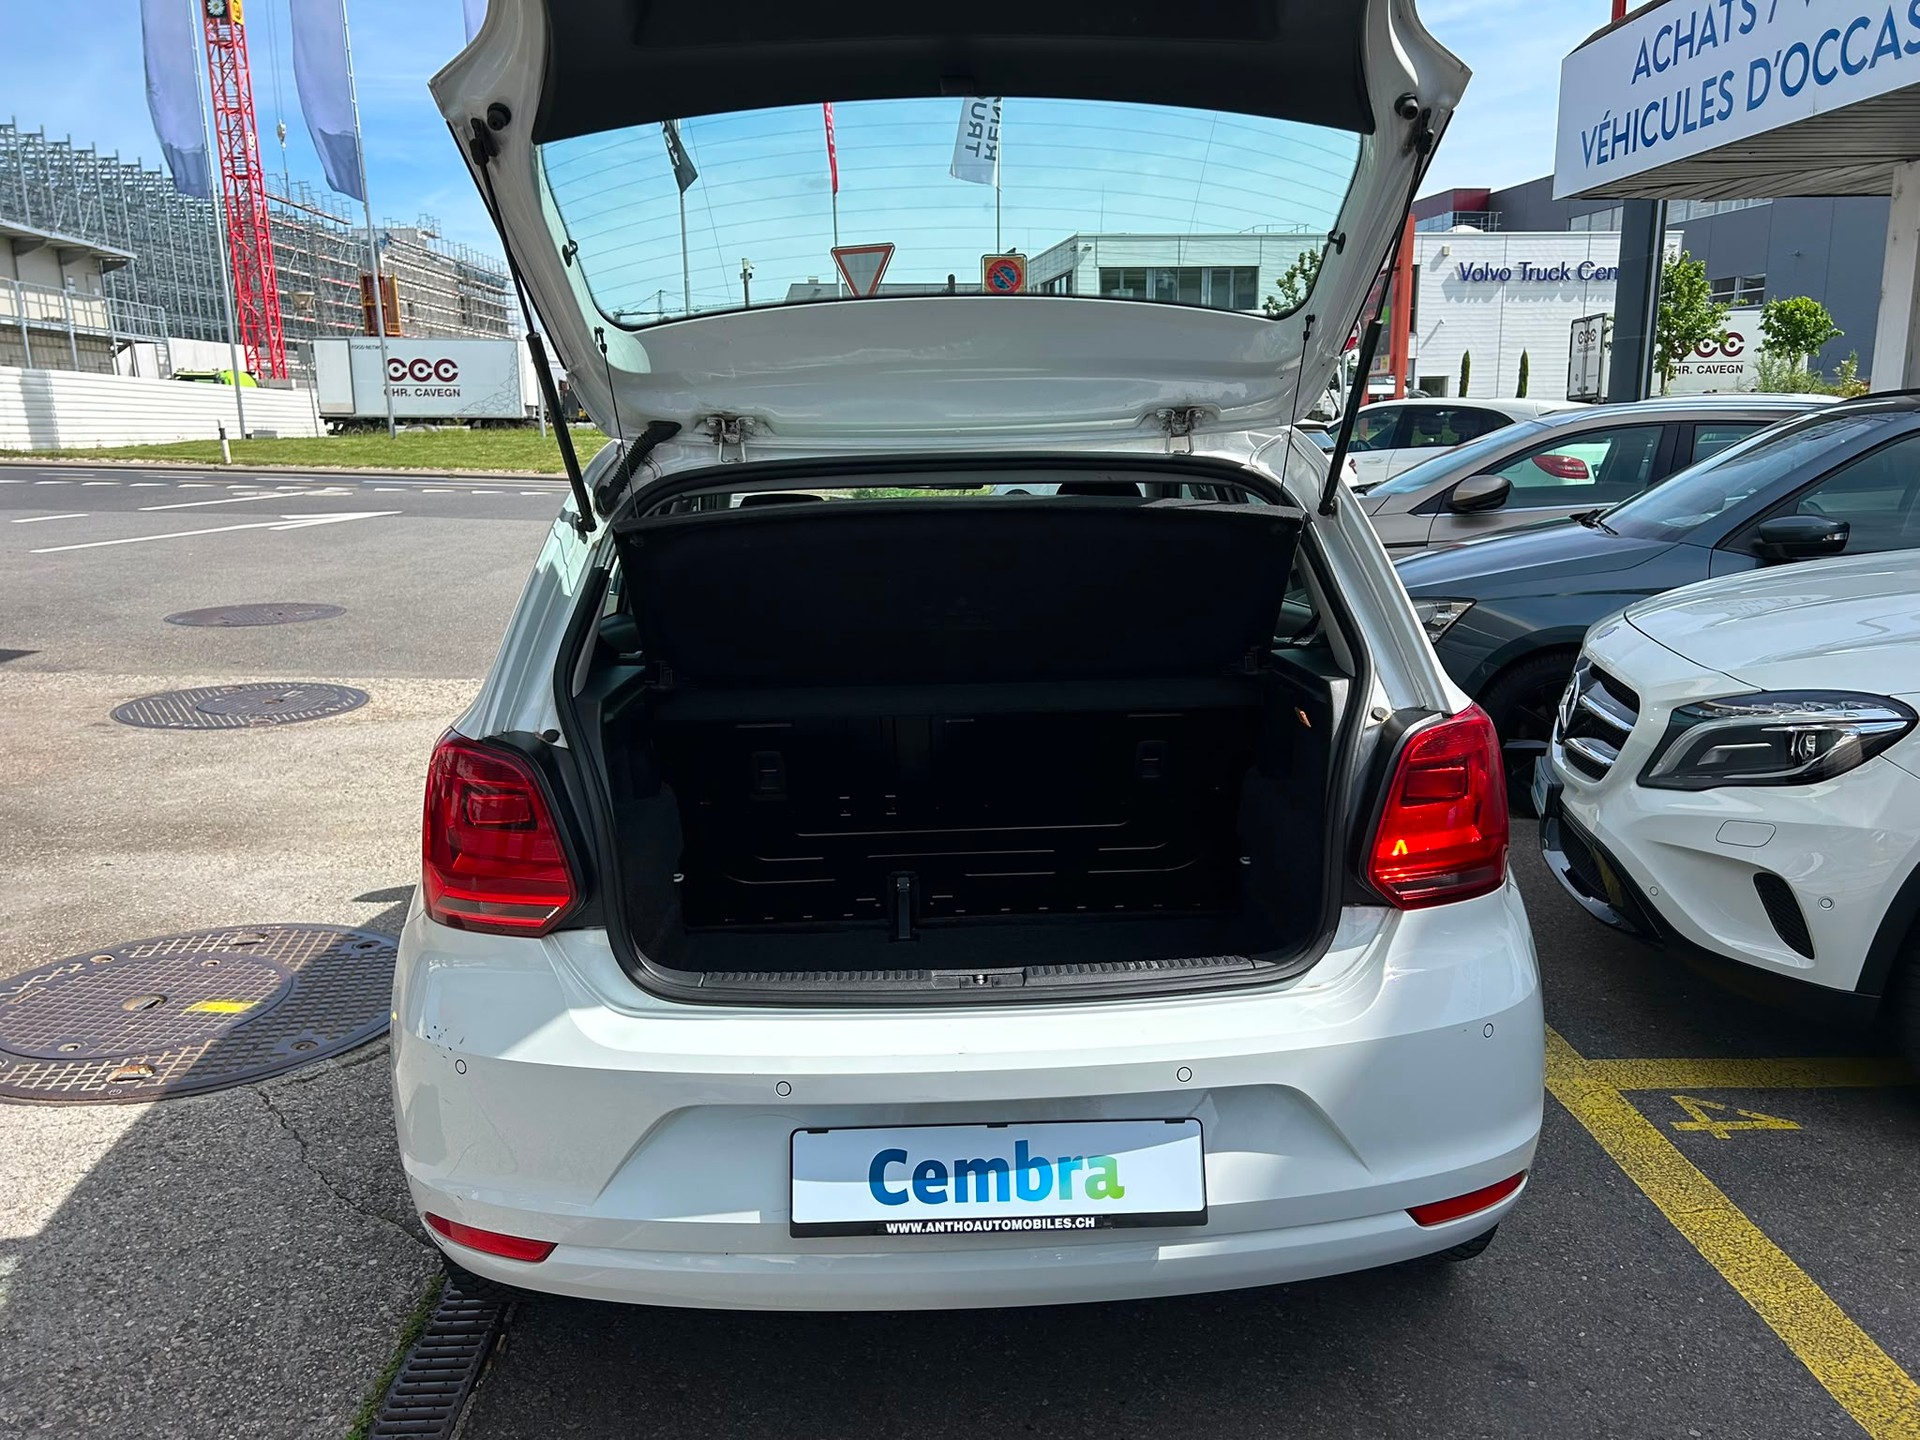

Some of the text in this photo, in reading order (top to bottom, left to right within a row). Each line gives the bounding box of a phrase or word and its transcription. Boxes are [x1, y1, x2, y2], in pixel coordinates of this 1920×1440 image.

[1631, 0, 1756, 85] ACHATS
[1581, 70, 1735, 168] VÉHICULES
[1459, 262, 1511, 281] Volvo
[1518, 261, 1570, 280] Truck
[1697, 365, 1743, 374] CAVEGN
[415, 388, 460, 397] CAVEGN
[868, 1139, 1125, 1206] Cembra
[886, 1217, 1095, 1234] WWW.ANTHOAUTOMOBILES.CH
